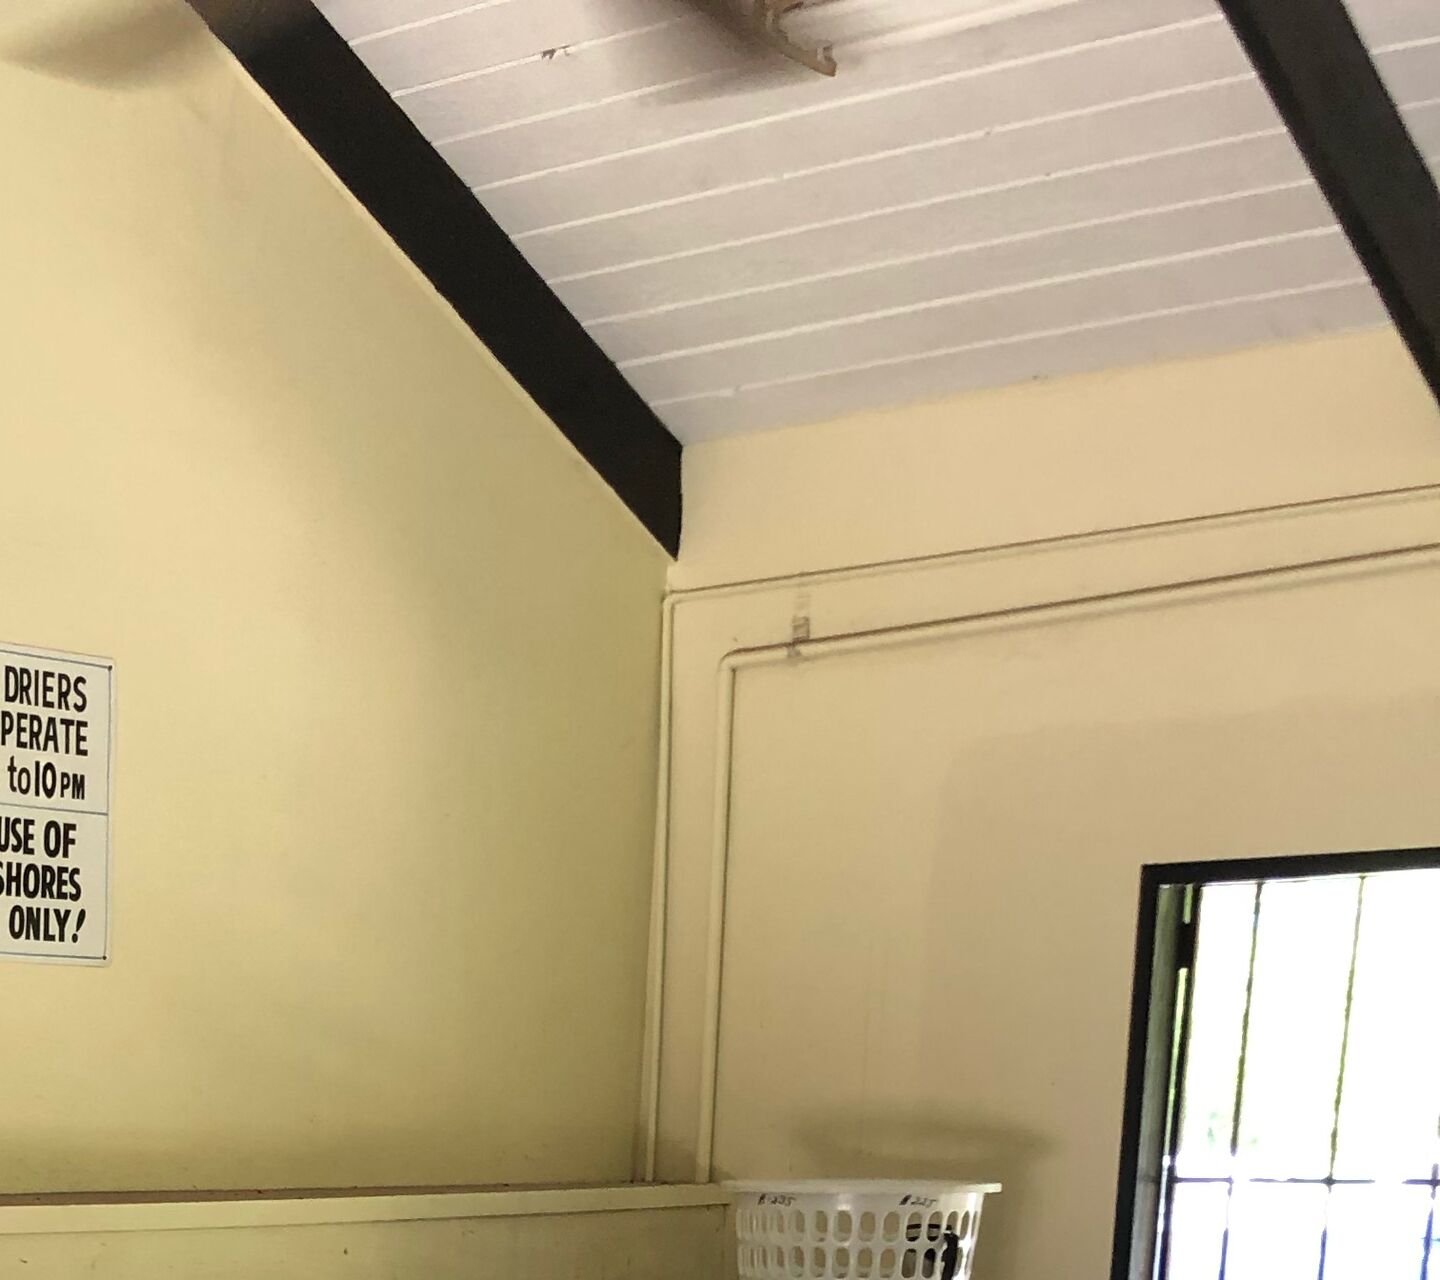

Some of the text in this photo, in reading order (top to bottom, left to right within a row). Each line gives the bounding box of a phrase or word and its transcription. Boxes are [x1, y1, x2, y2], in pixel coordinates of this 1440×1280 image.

[5, 665, 87, 712] DRIERS
[7, 756, 31, 795] to
[60, 772, 85, 800] PM
[44, 820, 76, 858] OF
[9, 905, 86, 943] ONLY!
